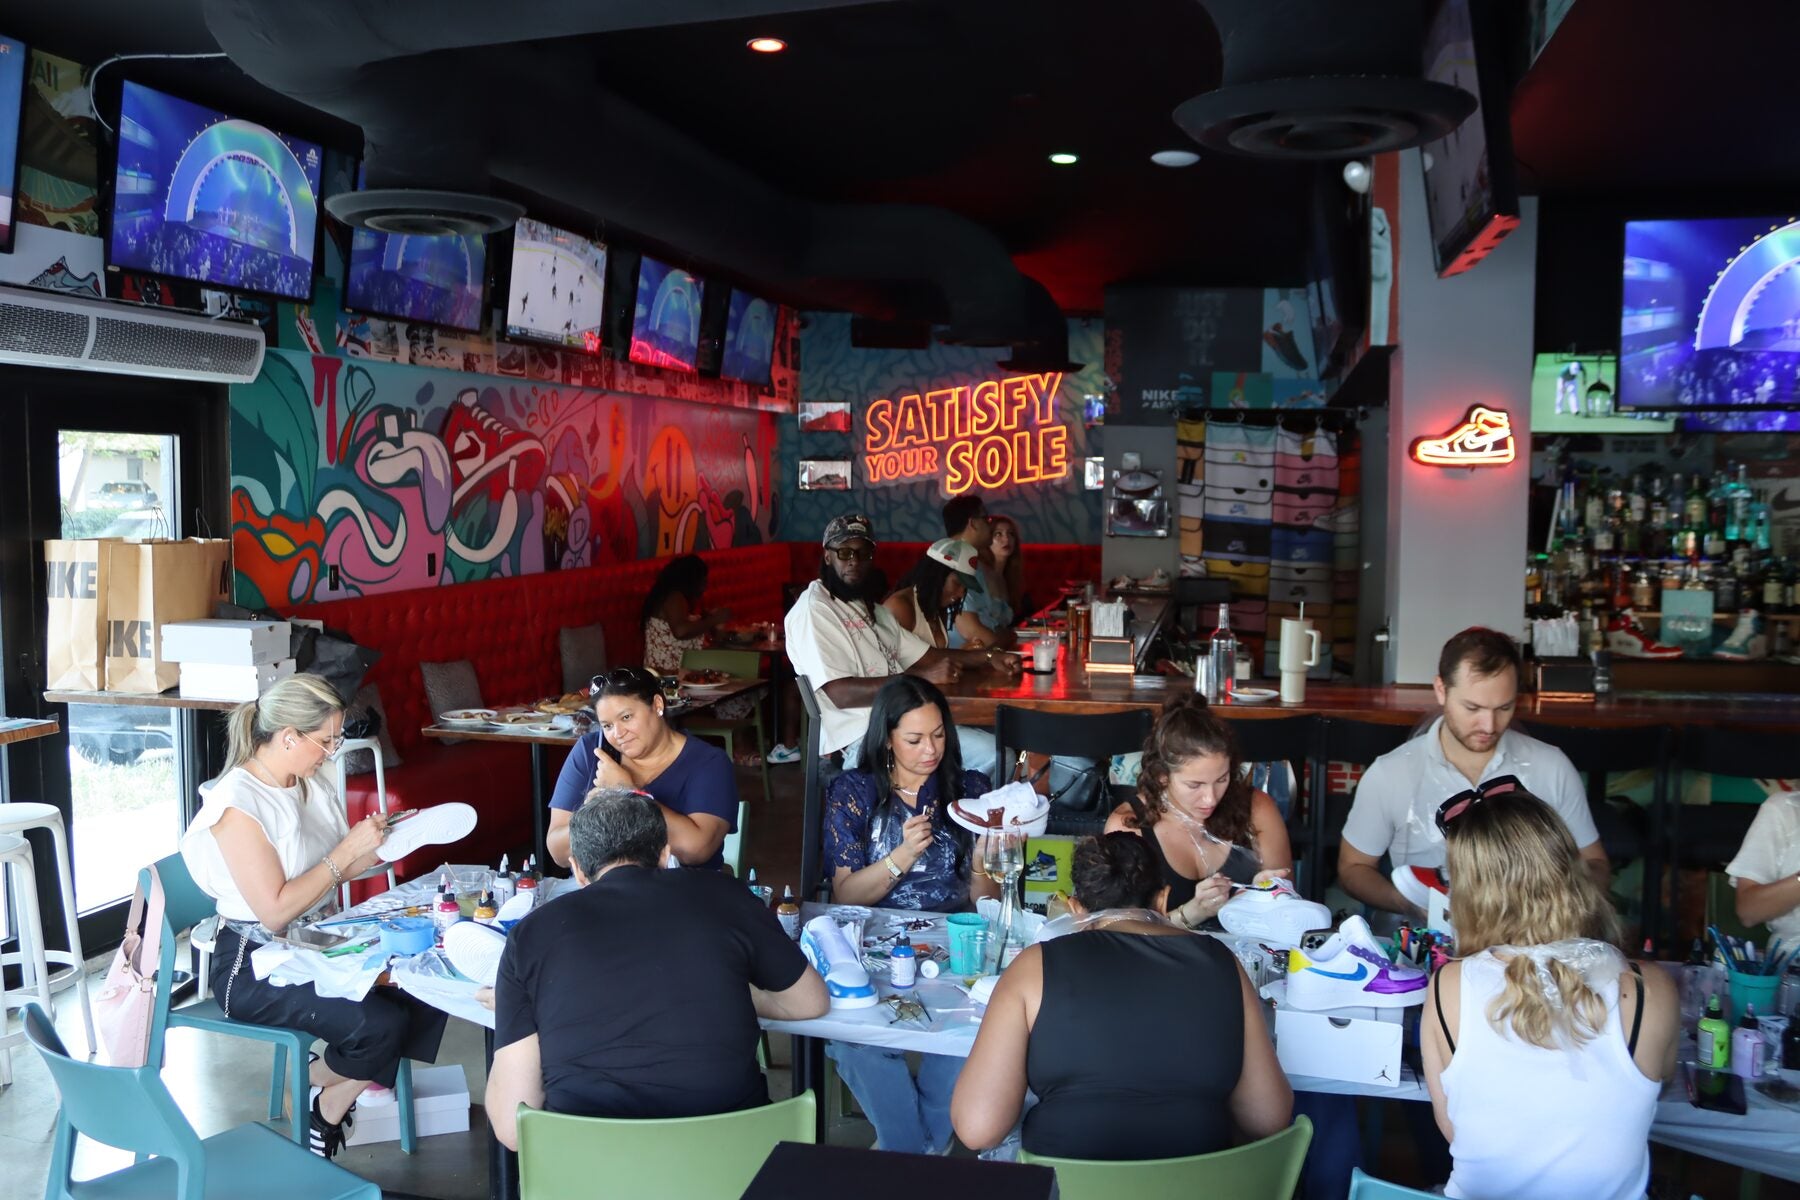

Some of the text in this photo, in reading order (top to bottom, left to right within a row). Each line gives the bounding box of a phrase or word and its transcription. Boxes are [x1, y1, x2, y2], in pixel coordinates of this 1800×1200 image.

[865, 371, 1063, 452] SATISFY
[1141, 389, 1179, 401] NIKE
[865, 425, 1067, 494] YOUR SOLE
